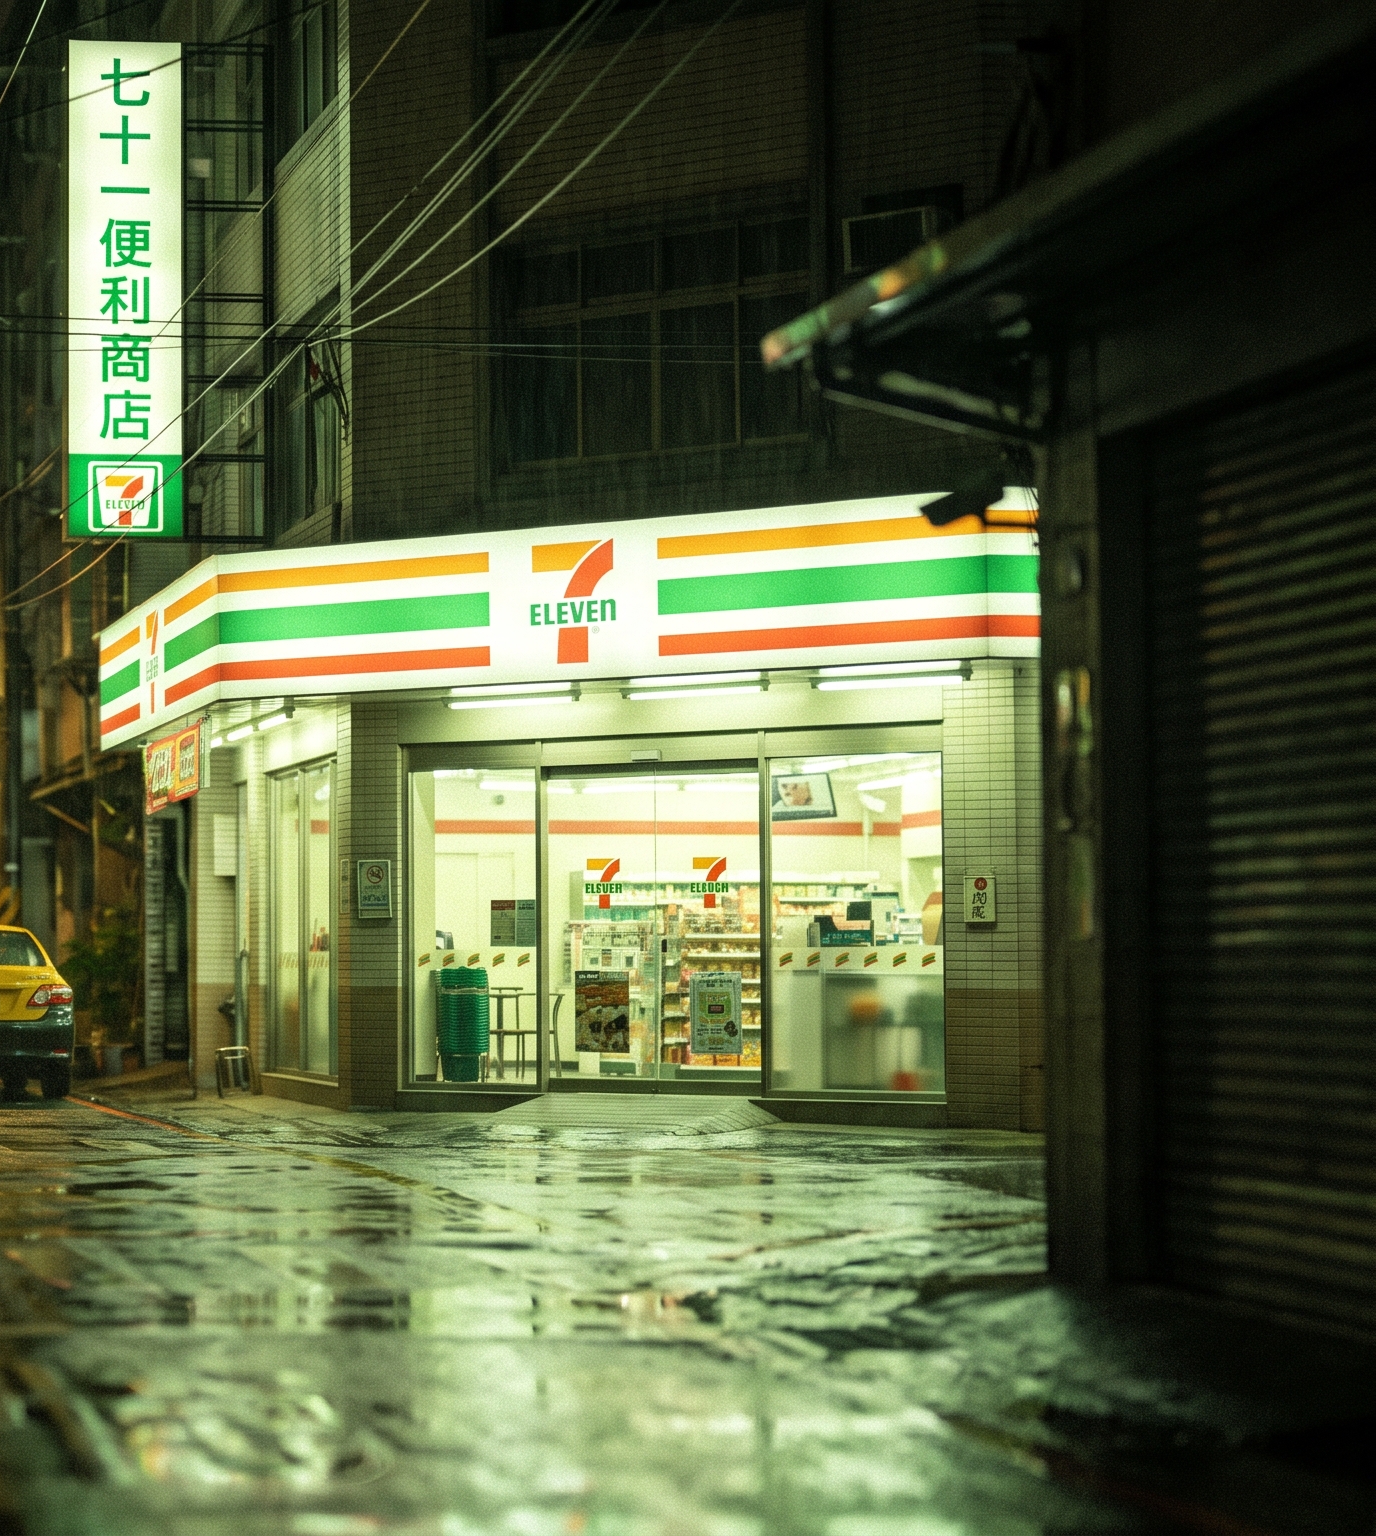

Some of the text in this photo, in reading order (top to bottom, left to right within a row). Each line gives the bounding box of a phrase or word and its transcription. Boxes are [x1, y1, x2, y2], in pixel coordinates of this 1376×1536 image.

[99, 57, 152, 440] 七十一便利商店
